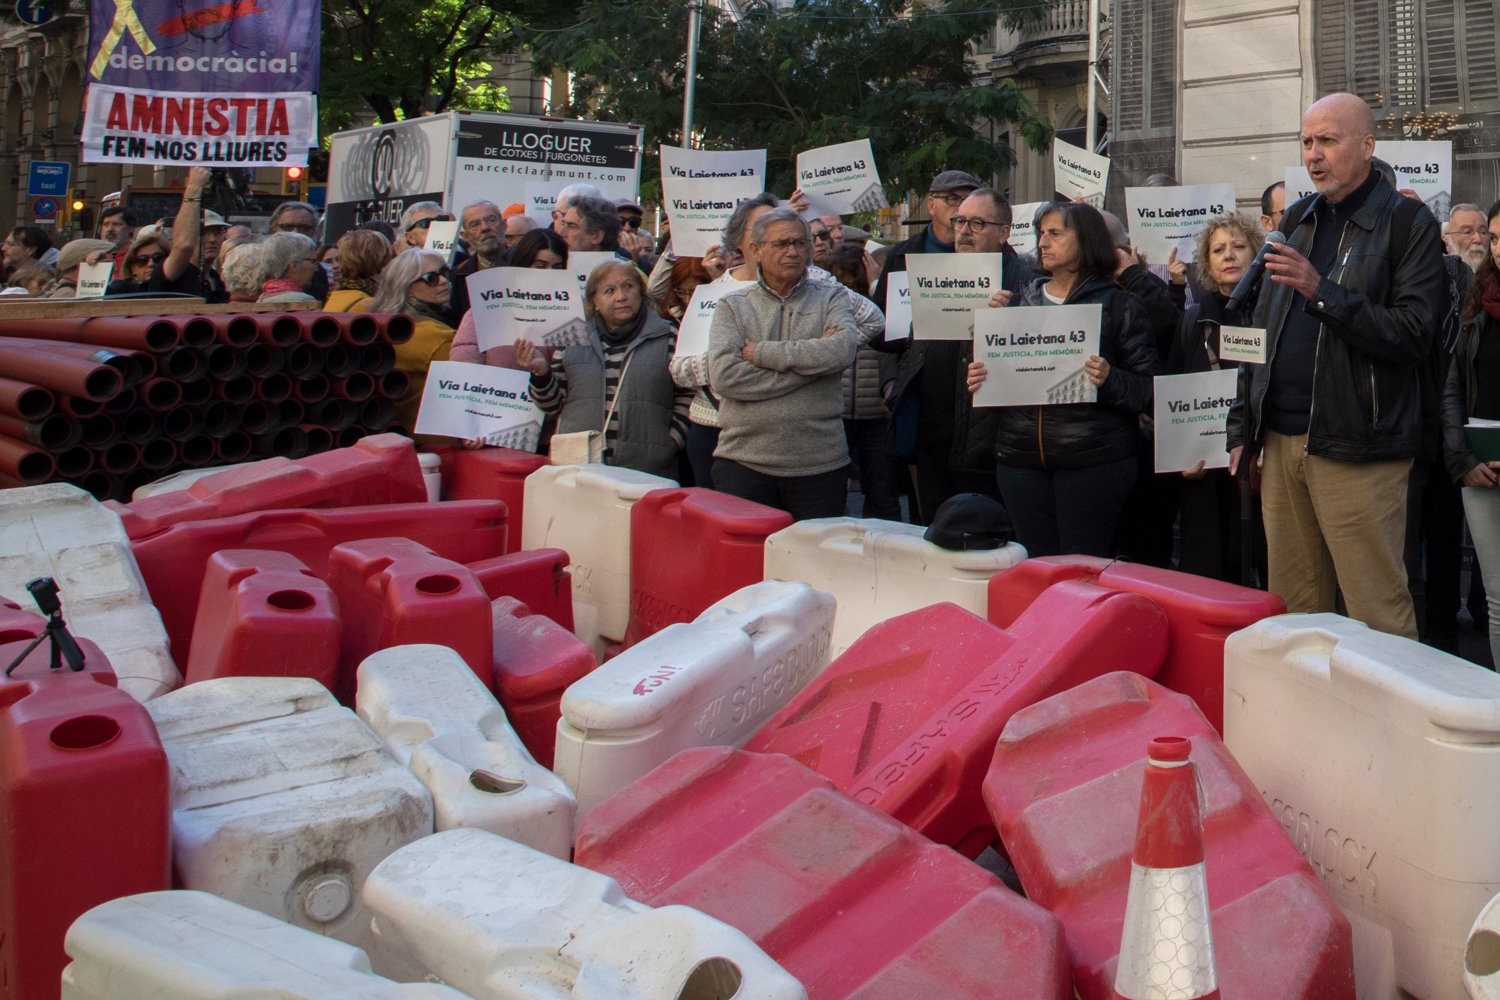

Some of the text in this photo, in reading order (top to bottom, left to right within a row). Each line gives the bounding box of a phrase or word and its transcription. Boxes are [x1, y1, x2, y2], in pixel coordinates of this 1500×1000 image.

[110, 46, 298, 74] democràcia!
[106, 92, 289, 136] AMNISTIA
[103, 136, 287, 162] FEM-NOS LLIURES
[502, 131, 591, 153] LLOGUER
[484, 147, 498, 156] DE
[500, 148, 538, 159] COTXES
[546, 152, 607, 164] FURGONETES
[464, 163, 626, 182] marcelclaramunt.com
[670, 166, 686, 177] Via
[741, 168, 754, 176] 43
[801, 160, 866, 180] Via Laietana 43
[1058, 154, 1066, 165] Via
[1067, 159, 1091, 175] Laietana
[1093, 169, 1101, 179] 43
[1424, 163, 1439, 174] 43
[672, 200, 687, 209] Via
[690, 200, 733, 210] Laietana
[1137, 204, 1223, 218] Via Laietana 43
[432, 241, 444, 249] Via
[917, 277, 990, 288] Via Laietana 43
[480, 288, 570, 301] Via Laietana 43
[899, 288, 910, 297] Vi
[985, 330, 1086, 346] Via Laietana 43
[1223, 334, 1261, 347] Via Laietana 43
[439, 380, 533, 402] Via Laietana 4
[1168, 397, 1234, 413] Via Laieta
